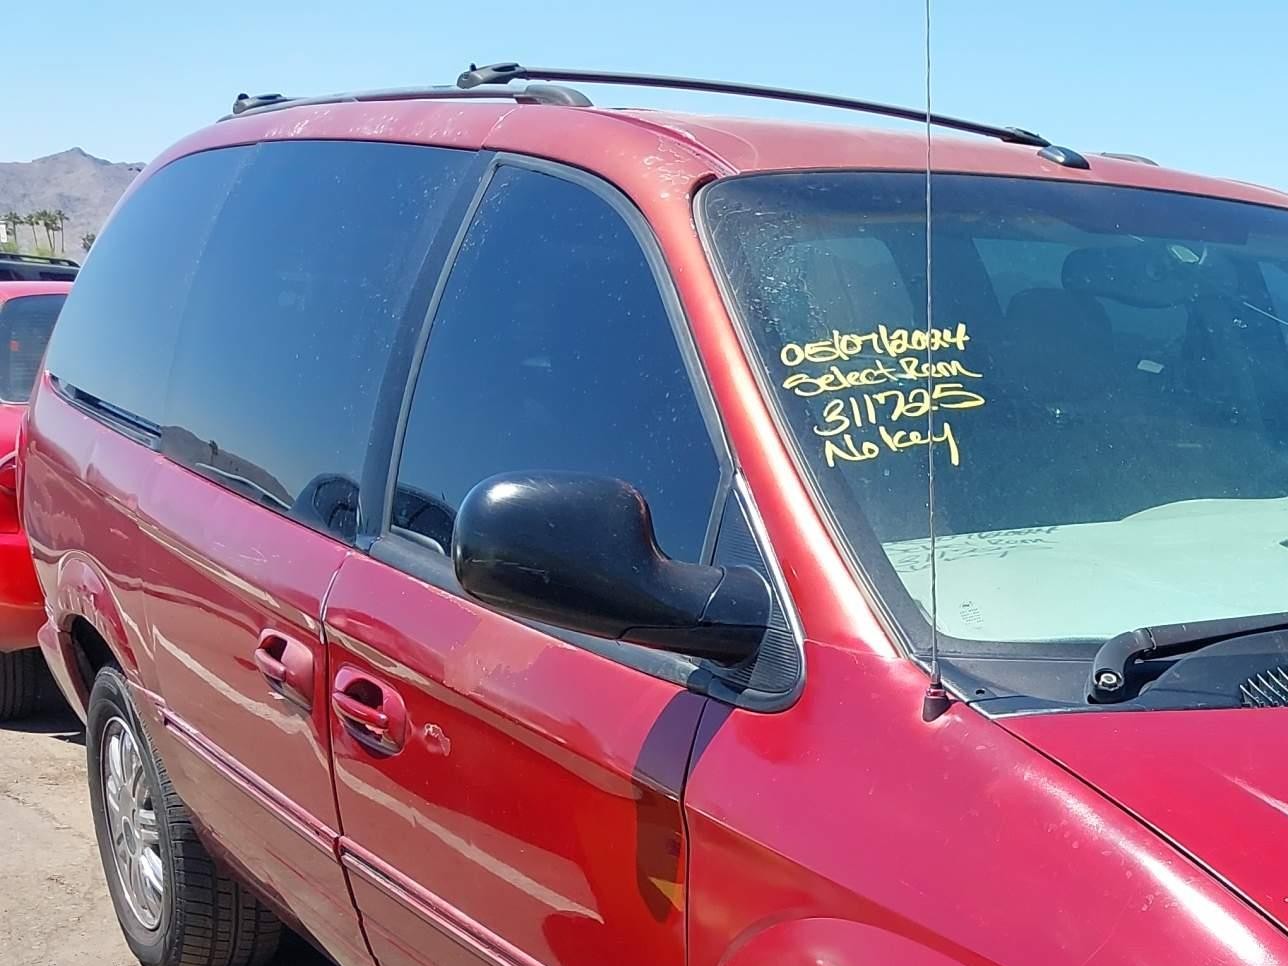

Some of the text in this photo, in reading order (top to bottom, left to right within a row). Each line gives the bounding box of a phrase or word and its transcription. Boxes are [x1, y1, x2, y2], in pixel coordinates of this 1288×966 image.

[780, 323, 970, 366] 05/07/2024
[813, 383, 985, 436] 311725
[824, 434, 879, 467] No
